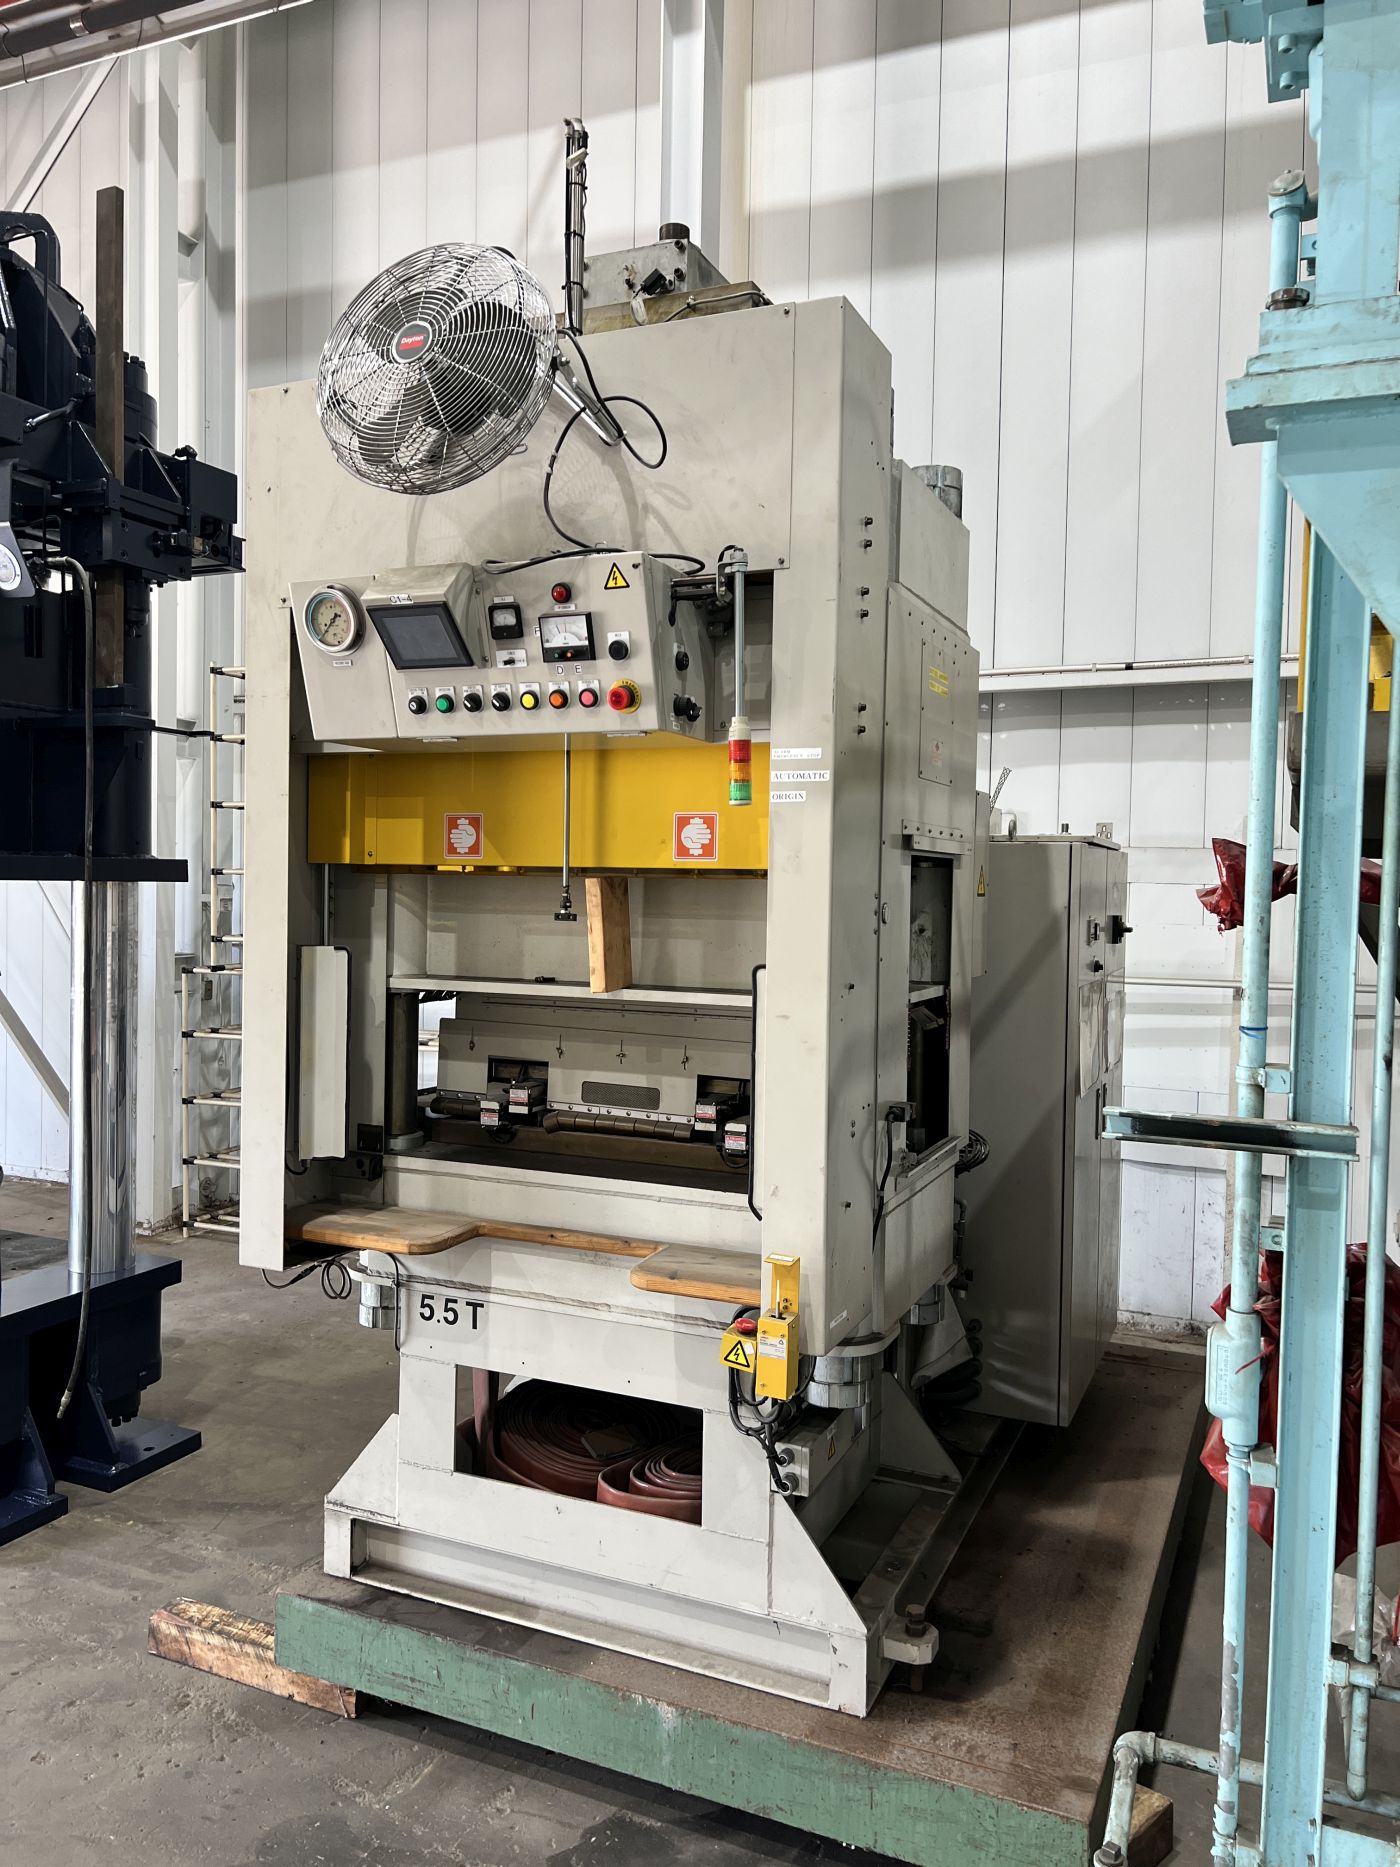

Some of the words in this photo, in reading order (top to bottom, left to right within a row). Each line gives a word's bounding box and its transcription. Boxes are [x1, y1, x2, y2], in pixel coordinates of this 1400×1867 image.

[401, 335, 424, 344] Dayton
[556, 665, 564, 675] D
[575, 664, 581, 674] E
[774, 772, 829, 780] AUTOMATIC
[771, 792, 804, 800] ORIGIN
